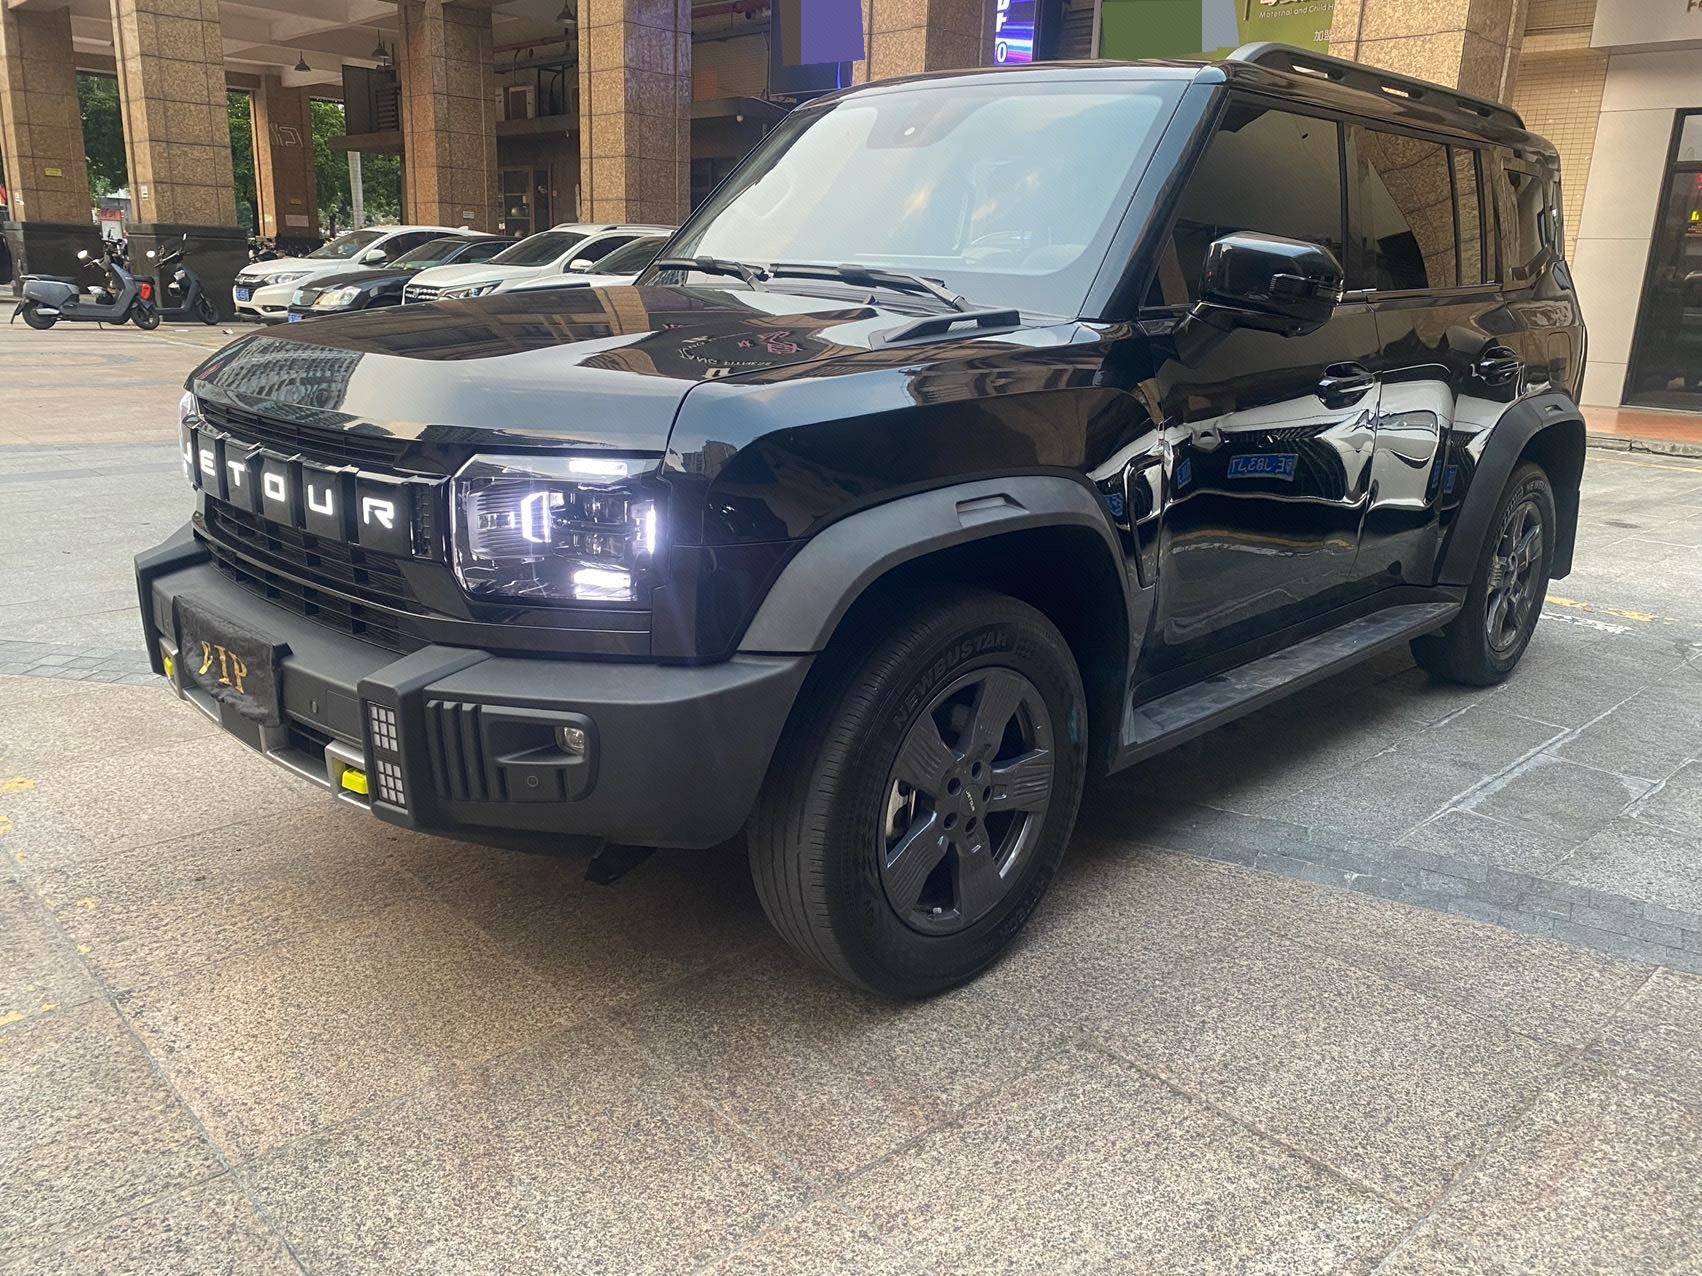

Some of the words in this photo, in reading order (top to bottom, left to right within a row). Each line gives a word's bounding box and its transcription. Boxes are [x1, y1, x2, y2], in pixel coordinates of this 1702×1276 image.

[1259, 8, 1293, 18] Maternal
[1294, 7, 1308, 15] and
[1308, 4, 1327, 13] Child
[184, 442, 395, 529] JETOUR
[199, 640, 248, 694] VIP
